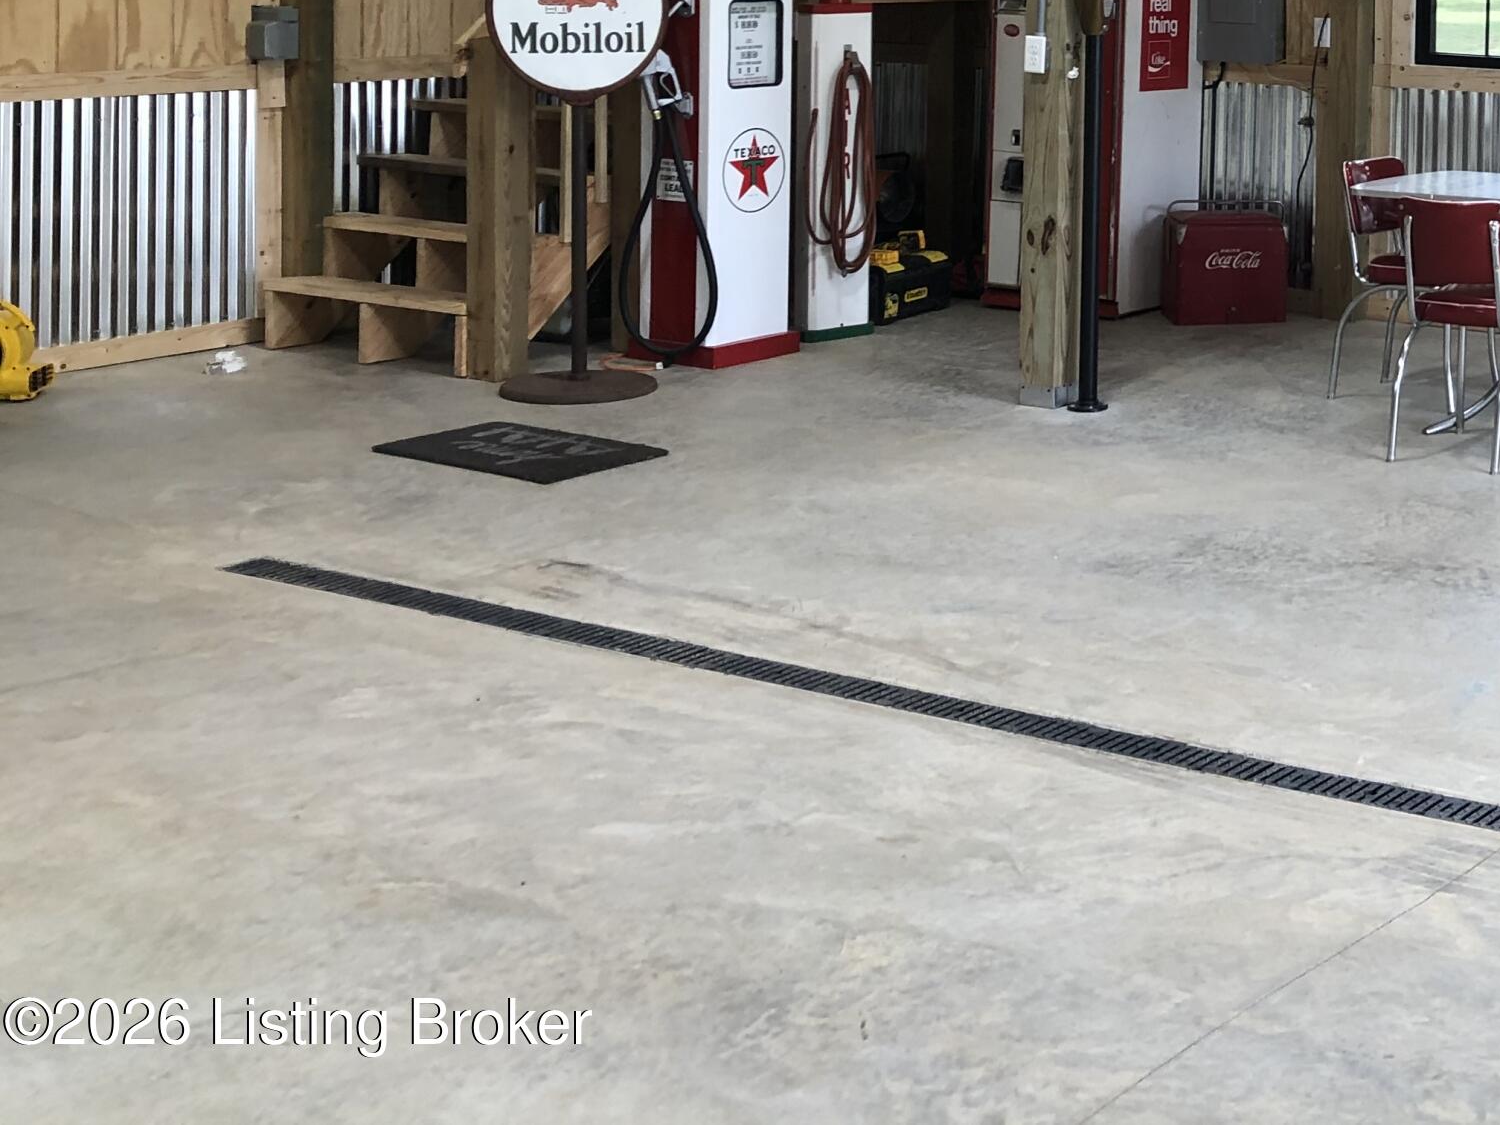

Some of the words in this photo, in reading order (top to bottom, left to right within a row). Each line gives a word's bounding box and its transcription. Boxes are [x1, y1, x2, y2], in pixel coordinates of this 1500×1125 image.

[1148, 15, 1178, 37] thing
[510, 21, 646, 54] Mobiloil
[733, 145, 776, 159] TEXACO
[1205, 250, 1262, 270] Coca-Cola
